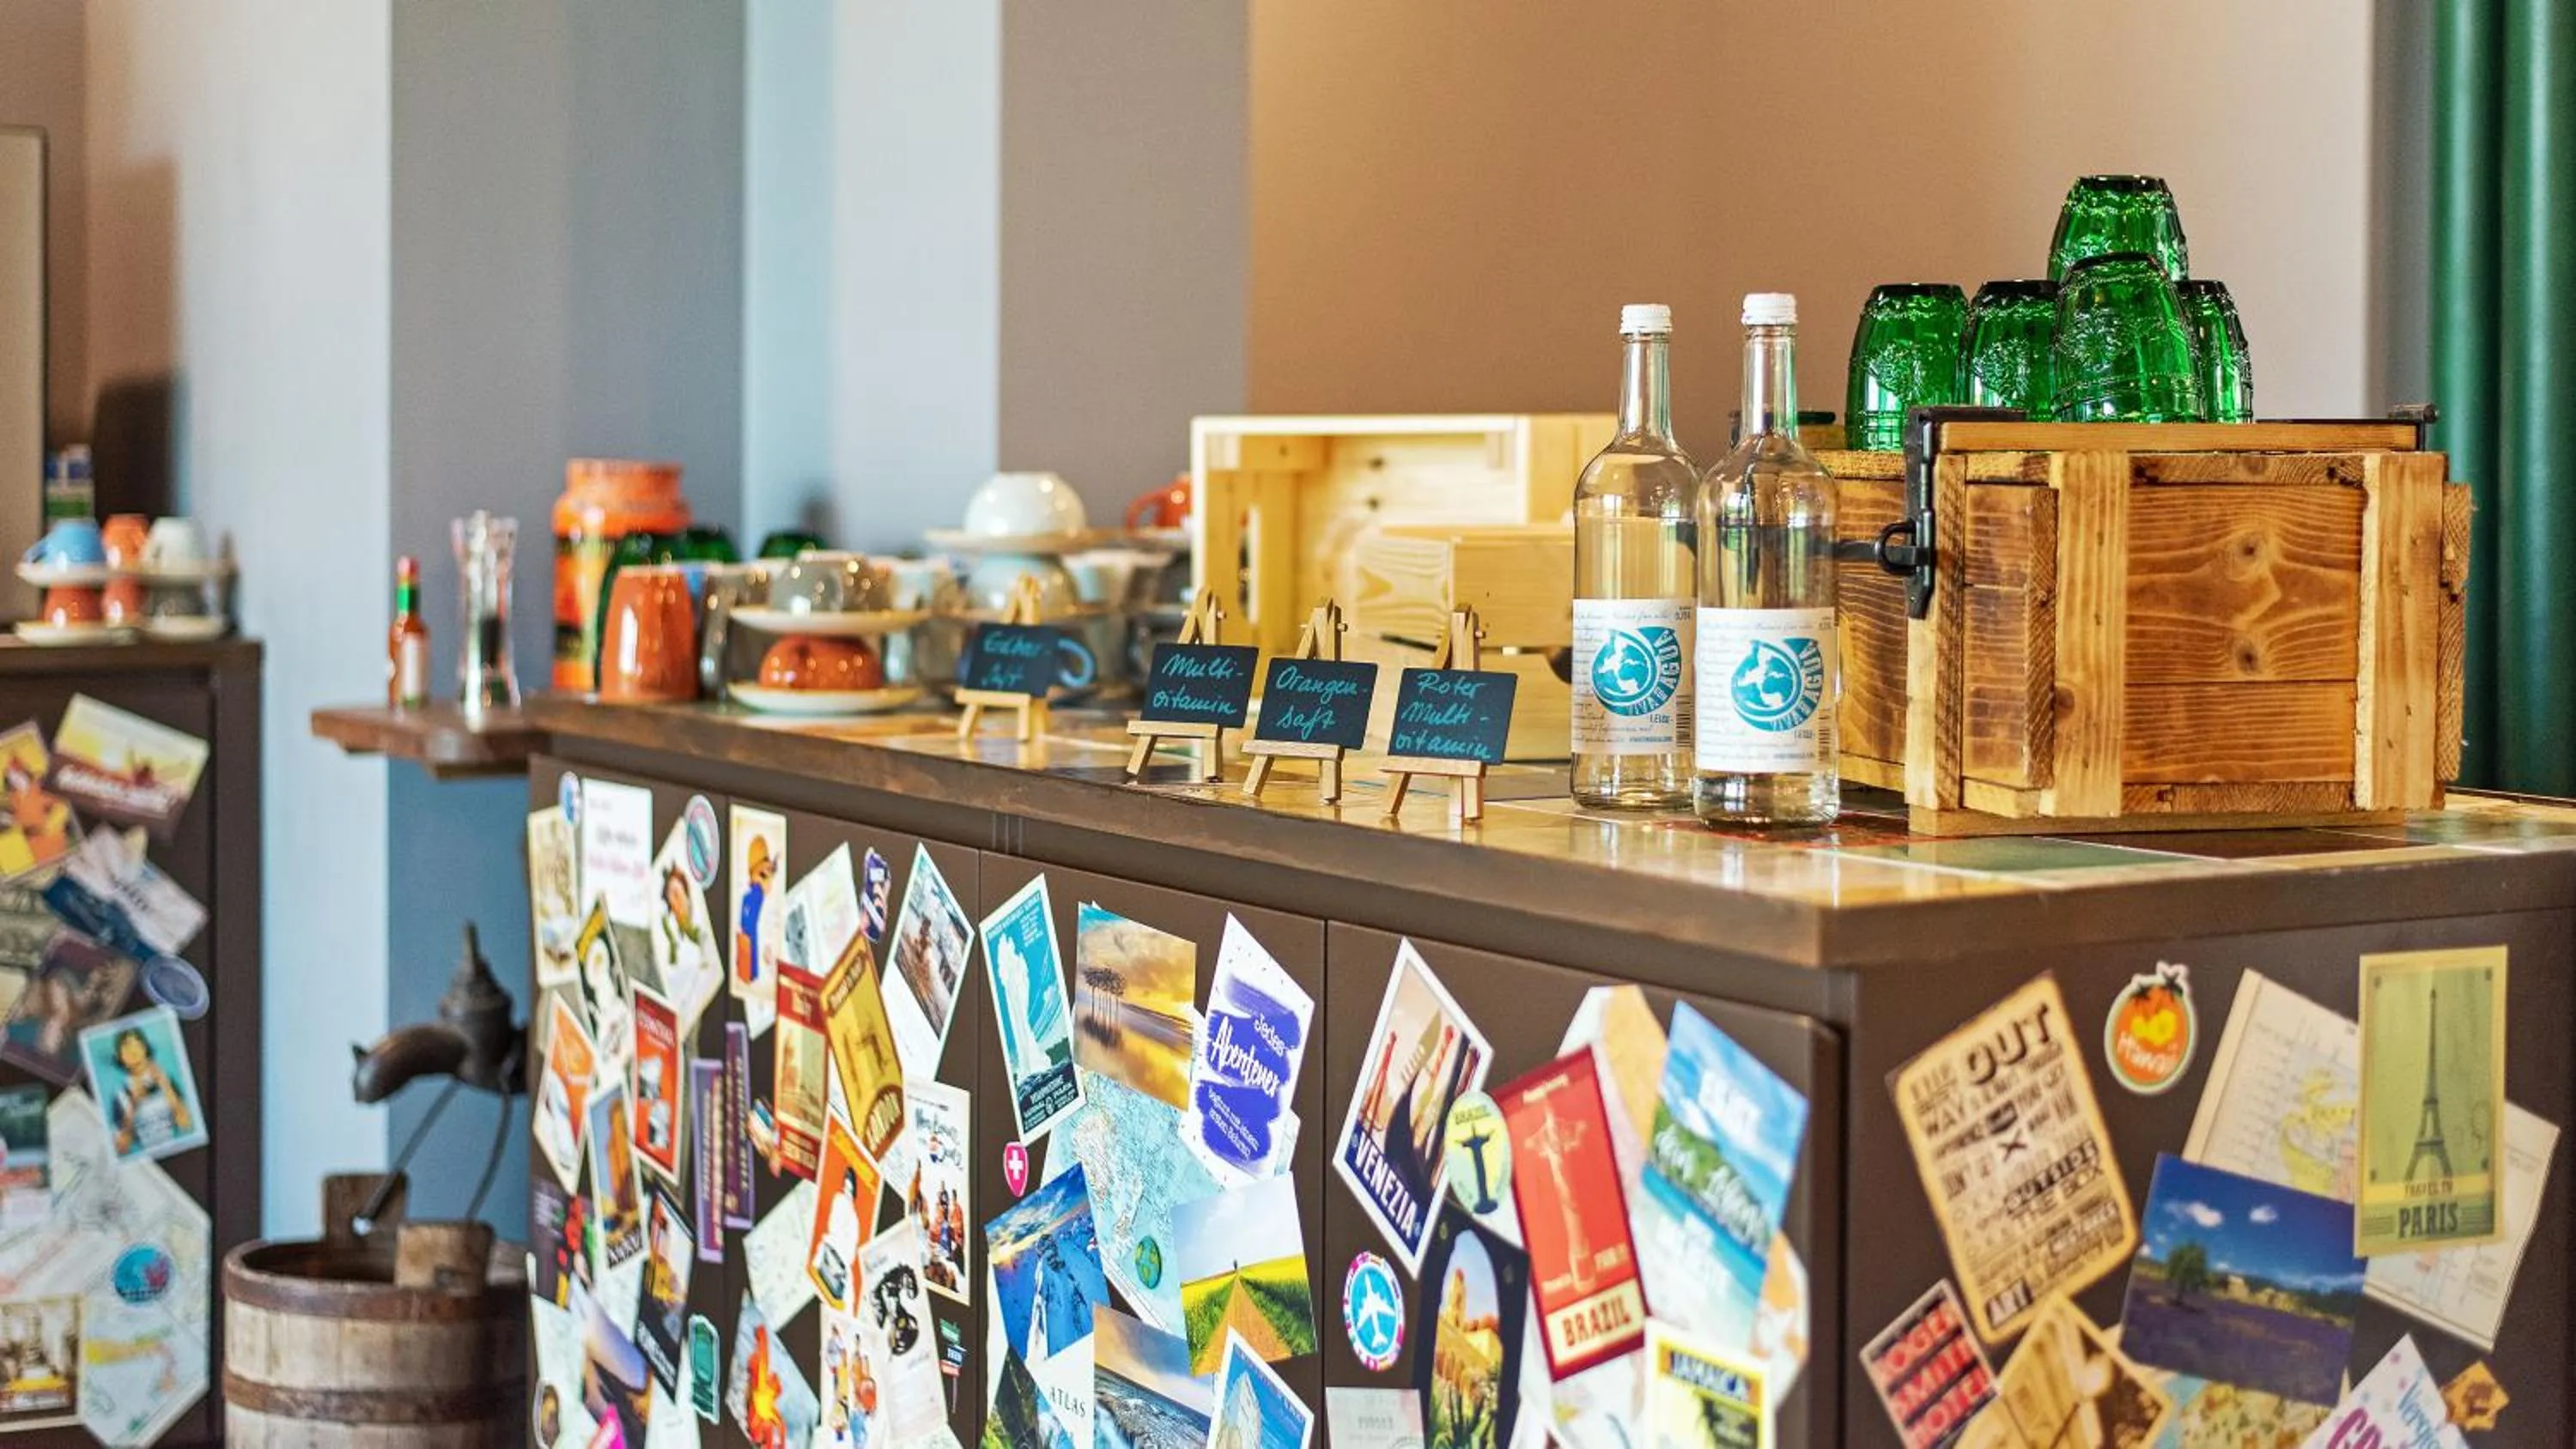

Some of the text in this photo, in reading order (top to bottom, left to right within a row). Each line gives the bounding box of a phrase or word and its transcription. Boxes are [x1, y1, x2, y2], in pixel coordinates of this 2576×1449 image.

[1418, 672, 1488, 700] Roter
[1211, 1016, 1280, 1098] Abenteuer
[1968, 1003, 2049, 1086] OUT
[1355, 1131, 1418, 1240] VENEZIA
[2399, 1202, 2458, 1239] PARIS
[1562, 1294, 1631, 1347] BRAZIL
[1048, 1385, 1086, 1418] ATLAS
